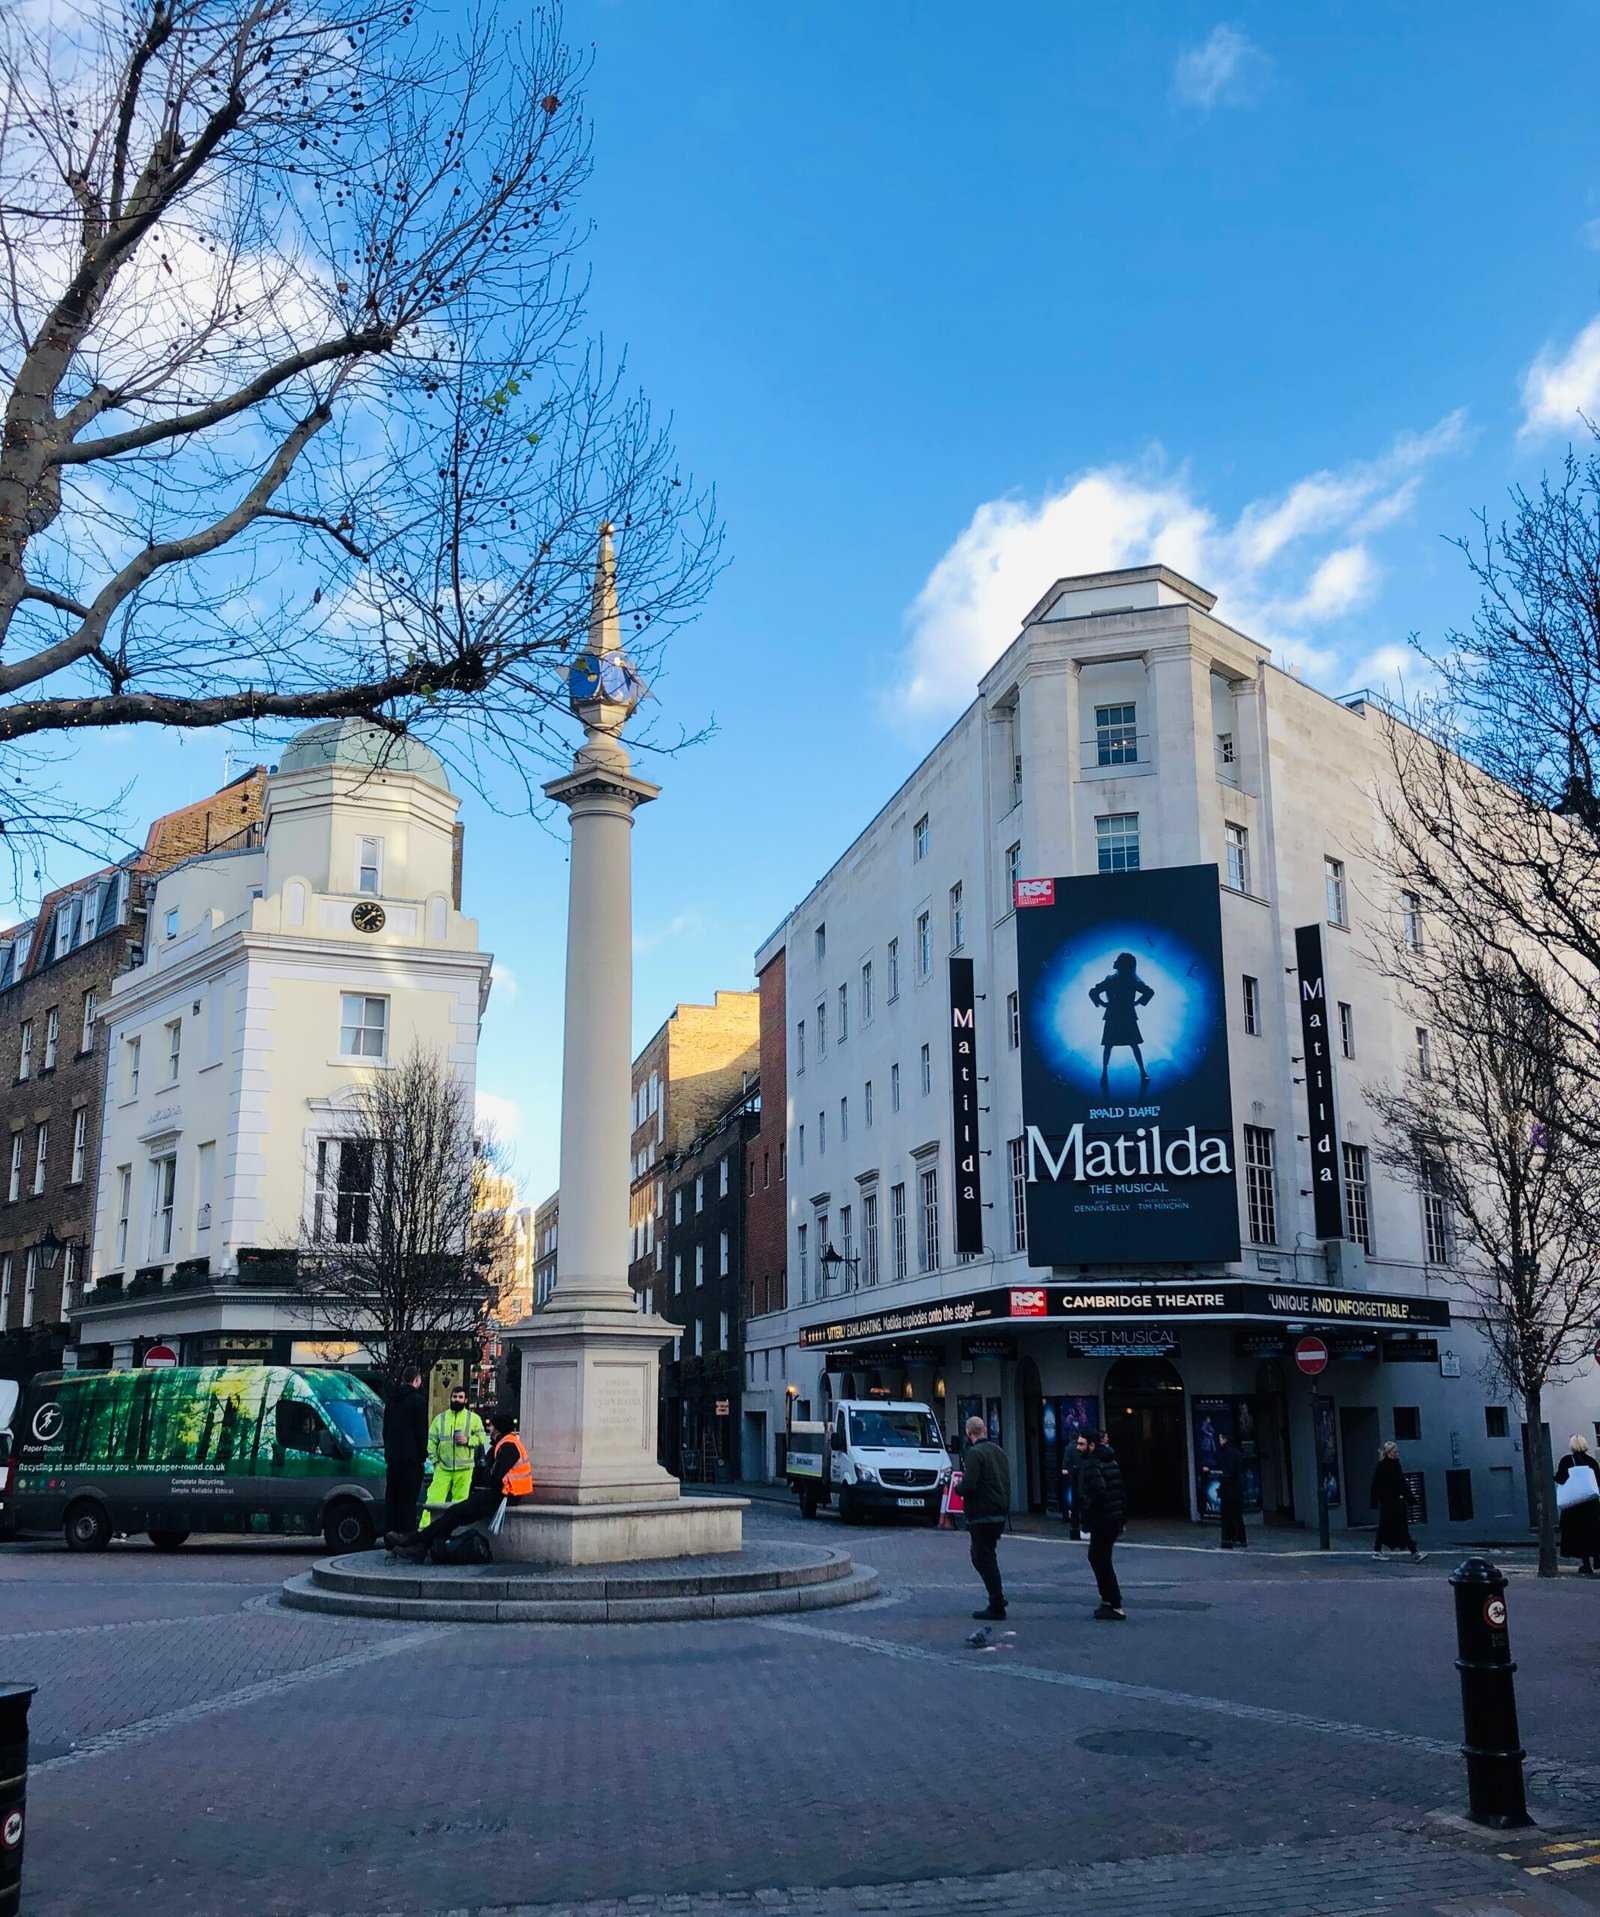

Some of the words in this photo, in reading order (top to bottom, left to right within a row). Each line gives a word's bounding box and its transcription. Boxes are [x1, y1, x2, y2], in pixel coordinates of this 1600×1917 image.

[1018, 880, 1051, 896] RSC
[1303, 977, 1332, 1182] Matilda
[953, 1007, 974, 1200] Matilda
[1089, 1107, 1124, 1119] ROALD
[1025, 1123, 1232, 1183] Matilda
[1089, 1184, 1113, 1194] THE
[1115, 1182, 1169, 1194] MUSICAL
[1074, 1204, 1104, 1213] DENNIS
[1106, 1203, 1131, 1211] KELLY
[1138, 1203, 1152, 1211] TIM
[1154, 1202, 1189, 1210] MINCHIN
[1010, 1291, 1044, 1307] RSC
[1062, 1295, 1152, 1308] CAMBRIDGE
[1155, 1294, 1225, 1307] THEATRE
[1311, 1298, 1332, 1313] AND
[882, 1312, 902, 1331] Matilda
[903, 1309, 928, 1330] explodes
[928, 1308, 943, 1324] onto
[943, 1304, 954, 1321] the
[1069, 1331, 1107, 1344] BEST
[1111, 1330, 1179, 1343] MUSICAL
[23, 1444, 42, 1452] Paper
[19, 1463, 53, 1472] Recycling
[74, 1463, 95, 1471] office
[115, 1464, 129, 1472] you
[136, 1463, 225, 1472] www.paper-round.co.uk
